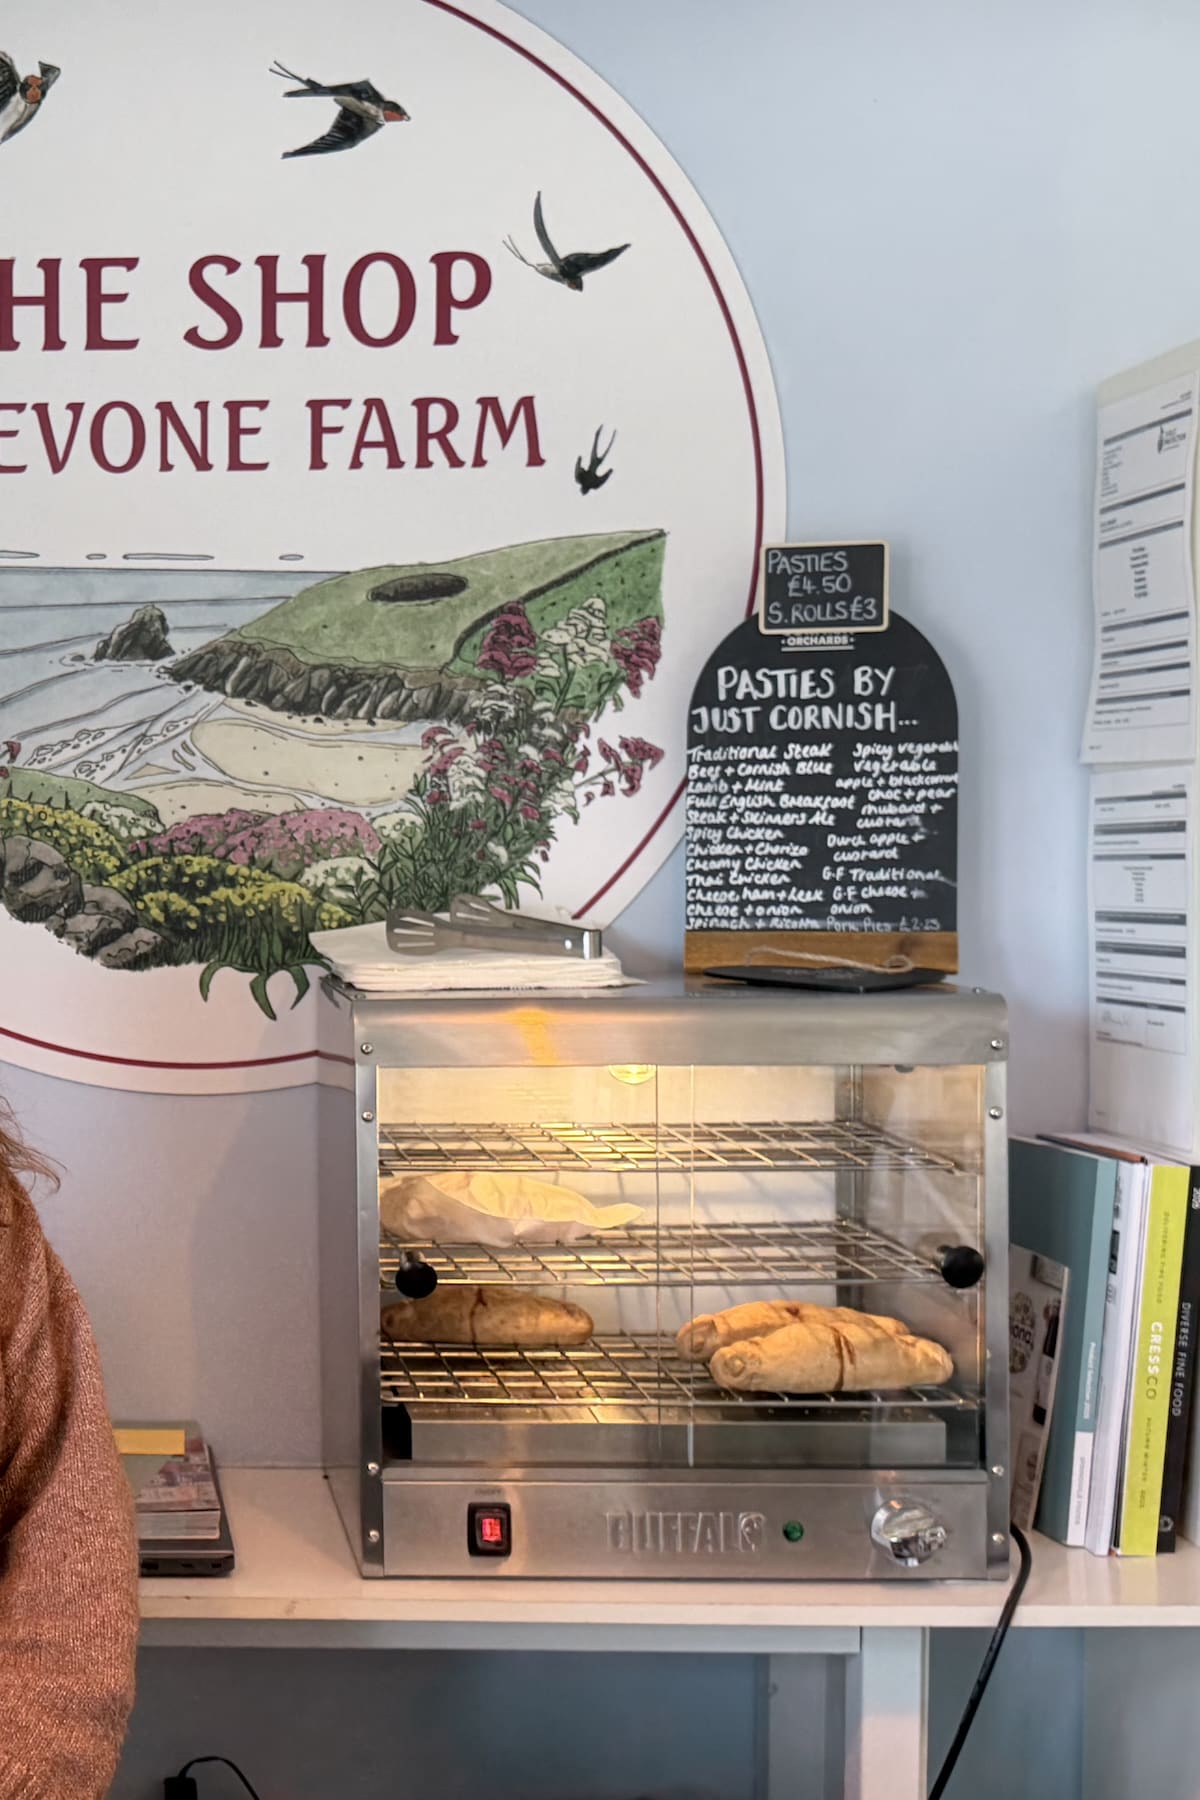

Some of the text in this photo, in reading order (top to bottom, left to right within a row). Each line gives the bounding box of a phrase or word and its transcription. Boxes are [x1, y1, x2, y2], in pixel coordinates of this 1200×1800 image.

[182, 251, 492, 350] SHOP
[305, 395, 546, 470] FARM
[768, 549, 848, 575] PASTIES
[787, 573, 852, 597] £4.50
[791, 601, 848, 624] ROLLS
[849, 596, 877, 621] £3
[717, 665, 896, 701] PASTIES BY
[691, 705, 762, 734] JUST
[687, 743, 833, 763] Traditional Steak
[852, 742, 893, 762] Spicy
[688, 763, 721, 782] Beef
[737, 761, 791, 776] Cornish
[796, 760, 833, 776] Blue
[687, 779, 729, 794] Lamb
[744, 777, 785, 792] Mint
[686, 794, 718, 810] Full
[719, 794, 776, 813] English
[686, 810, 728, 825] Steak
[808, 810, 835, 826] Ale
[684, 826, 784, 844] Spicy Chicken
[687, 842, 743, 857] Chicken
[754, 841, 809, 856] Chorizo
[686, 857, 802, 874] Creamy Chicken
[848, 867, 940, 882] Traditional
[686, 872, 791, 887] Thai Chicken
[1145, 1321, 1163, 1400] CRESSCO
[1172, 1302, 1191, 1417] DIVERSE FINE FOOD
